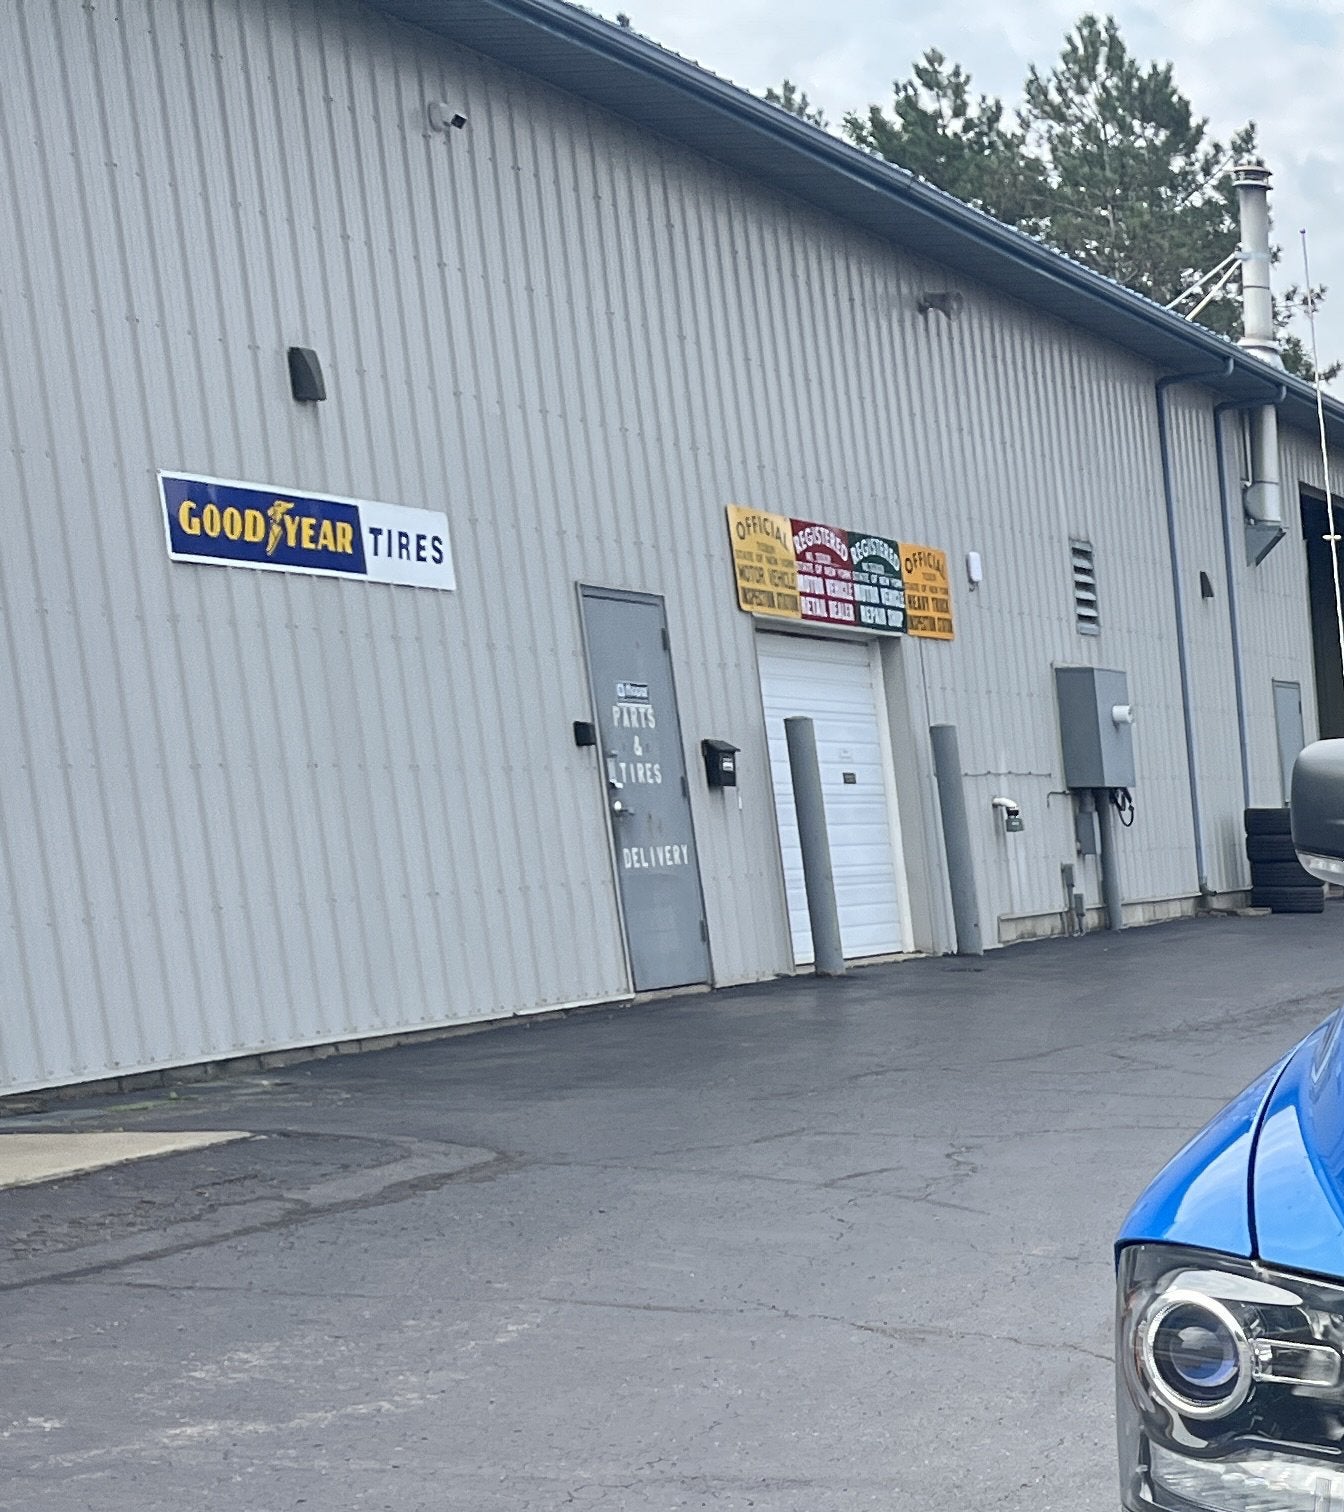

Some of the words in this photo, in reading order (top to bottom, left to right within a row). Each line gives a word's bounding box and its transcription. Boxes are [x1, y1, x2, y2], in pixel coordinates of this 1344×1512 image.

[178, 499, 354, 556] GOODYEAR
[368, 527, 444, 565] TIRES
[735, 515, 790, 552] OFFICIAL
[793, 526, 849, 562] REGISTERED
[850, 538, 900, 571] REGISTERED
[904, 551, 946, 580] OFFICIAL
[612, 705, 656, 729] PARTS
[619, 762, 662, 784] TIRES
[623, 844, 689, 869] DELIVERY
